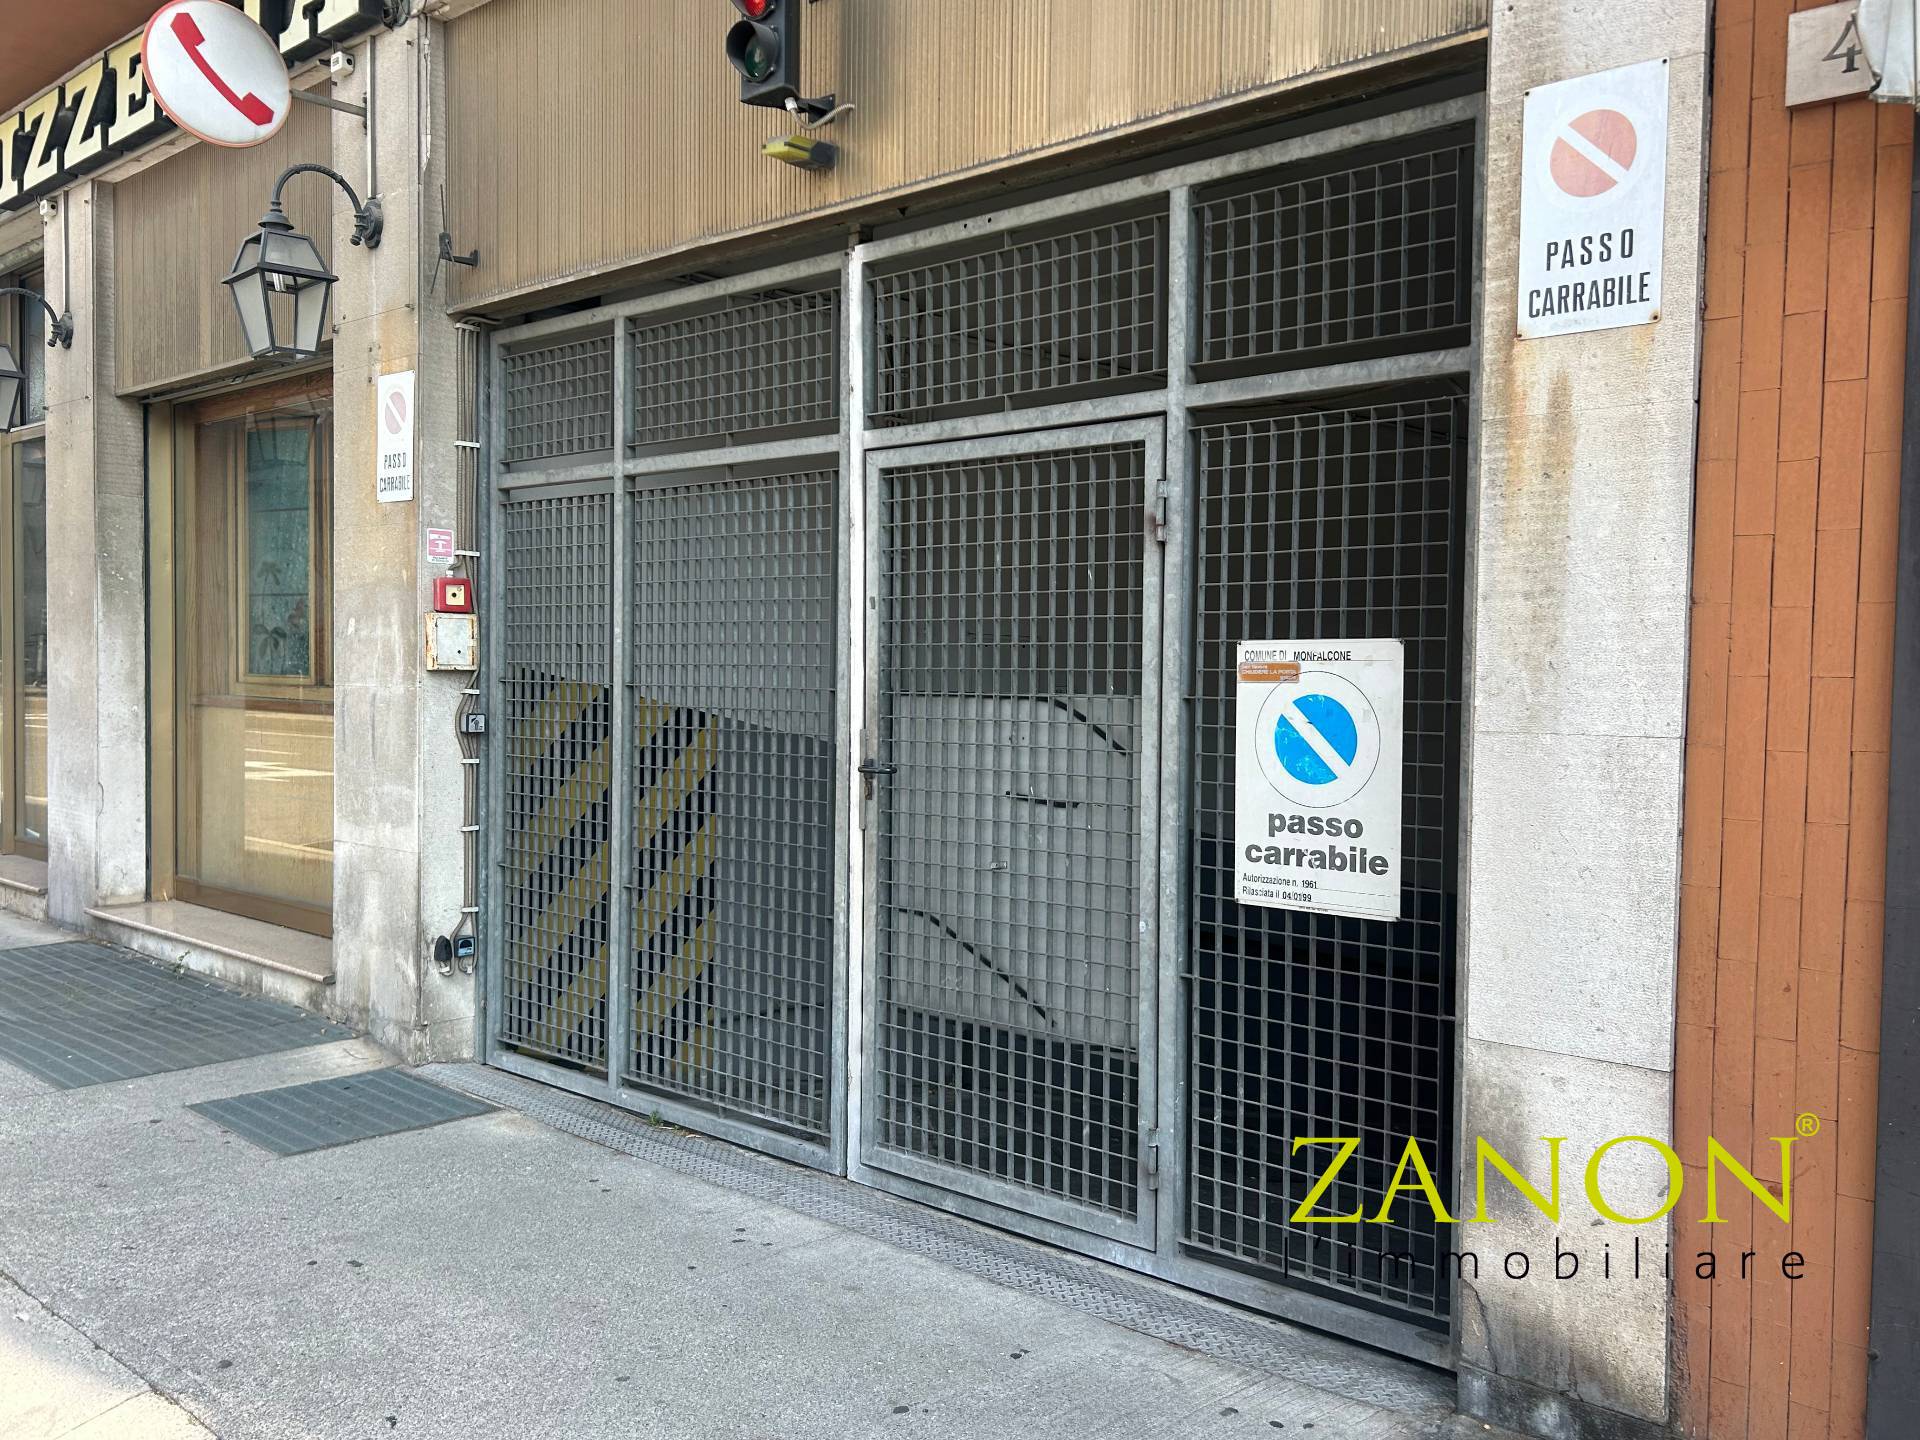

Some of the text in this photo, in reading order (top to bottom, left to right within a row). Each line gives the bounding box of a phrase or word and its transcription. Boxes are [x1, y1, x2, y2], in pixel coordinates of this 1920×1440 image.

[1821, 19, 1862, 73] 4
[1546, 228, 1634, 271] PASSO
[1528, 271, 1651, 318] CARRABILE
[383, 452, 407, 470] PASSO
[379, 474, 411, 493] CARRABILE
[1244, 650, 1352, 661] COMUNE DI MONFALCONE
[1268, 813, 1364, 839] passo
[1245, 844, 1389, 876] carrabile
[1242, 872, 1291, 886] Autorizzazione
[1301, 879, 1318, 889] 1961
